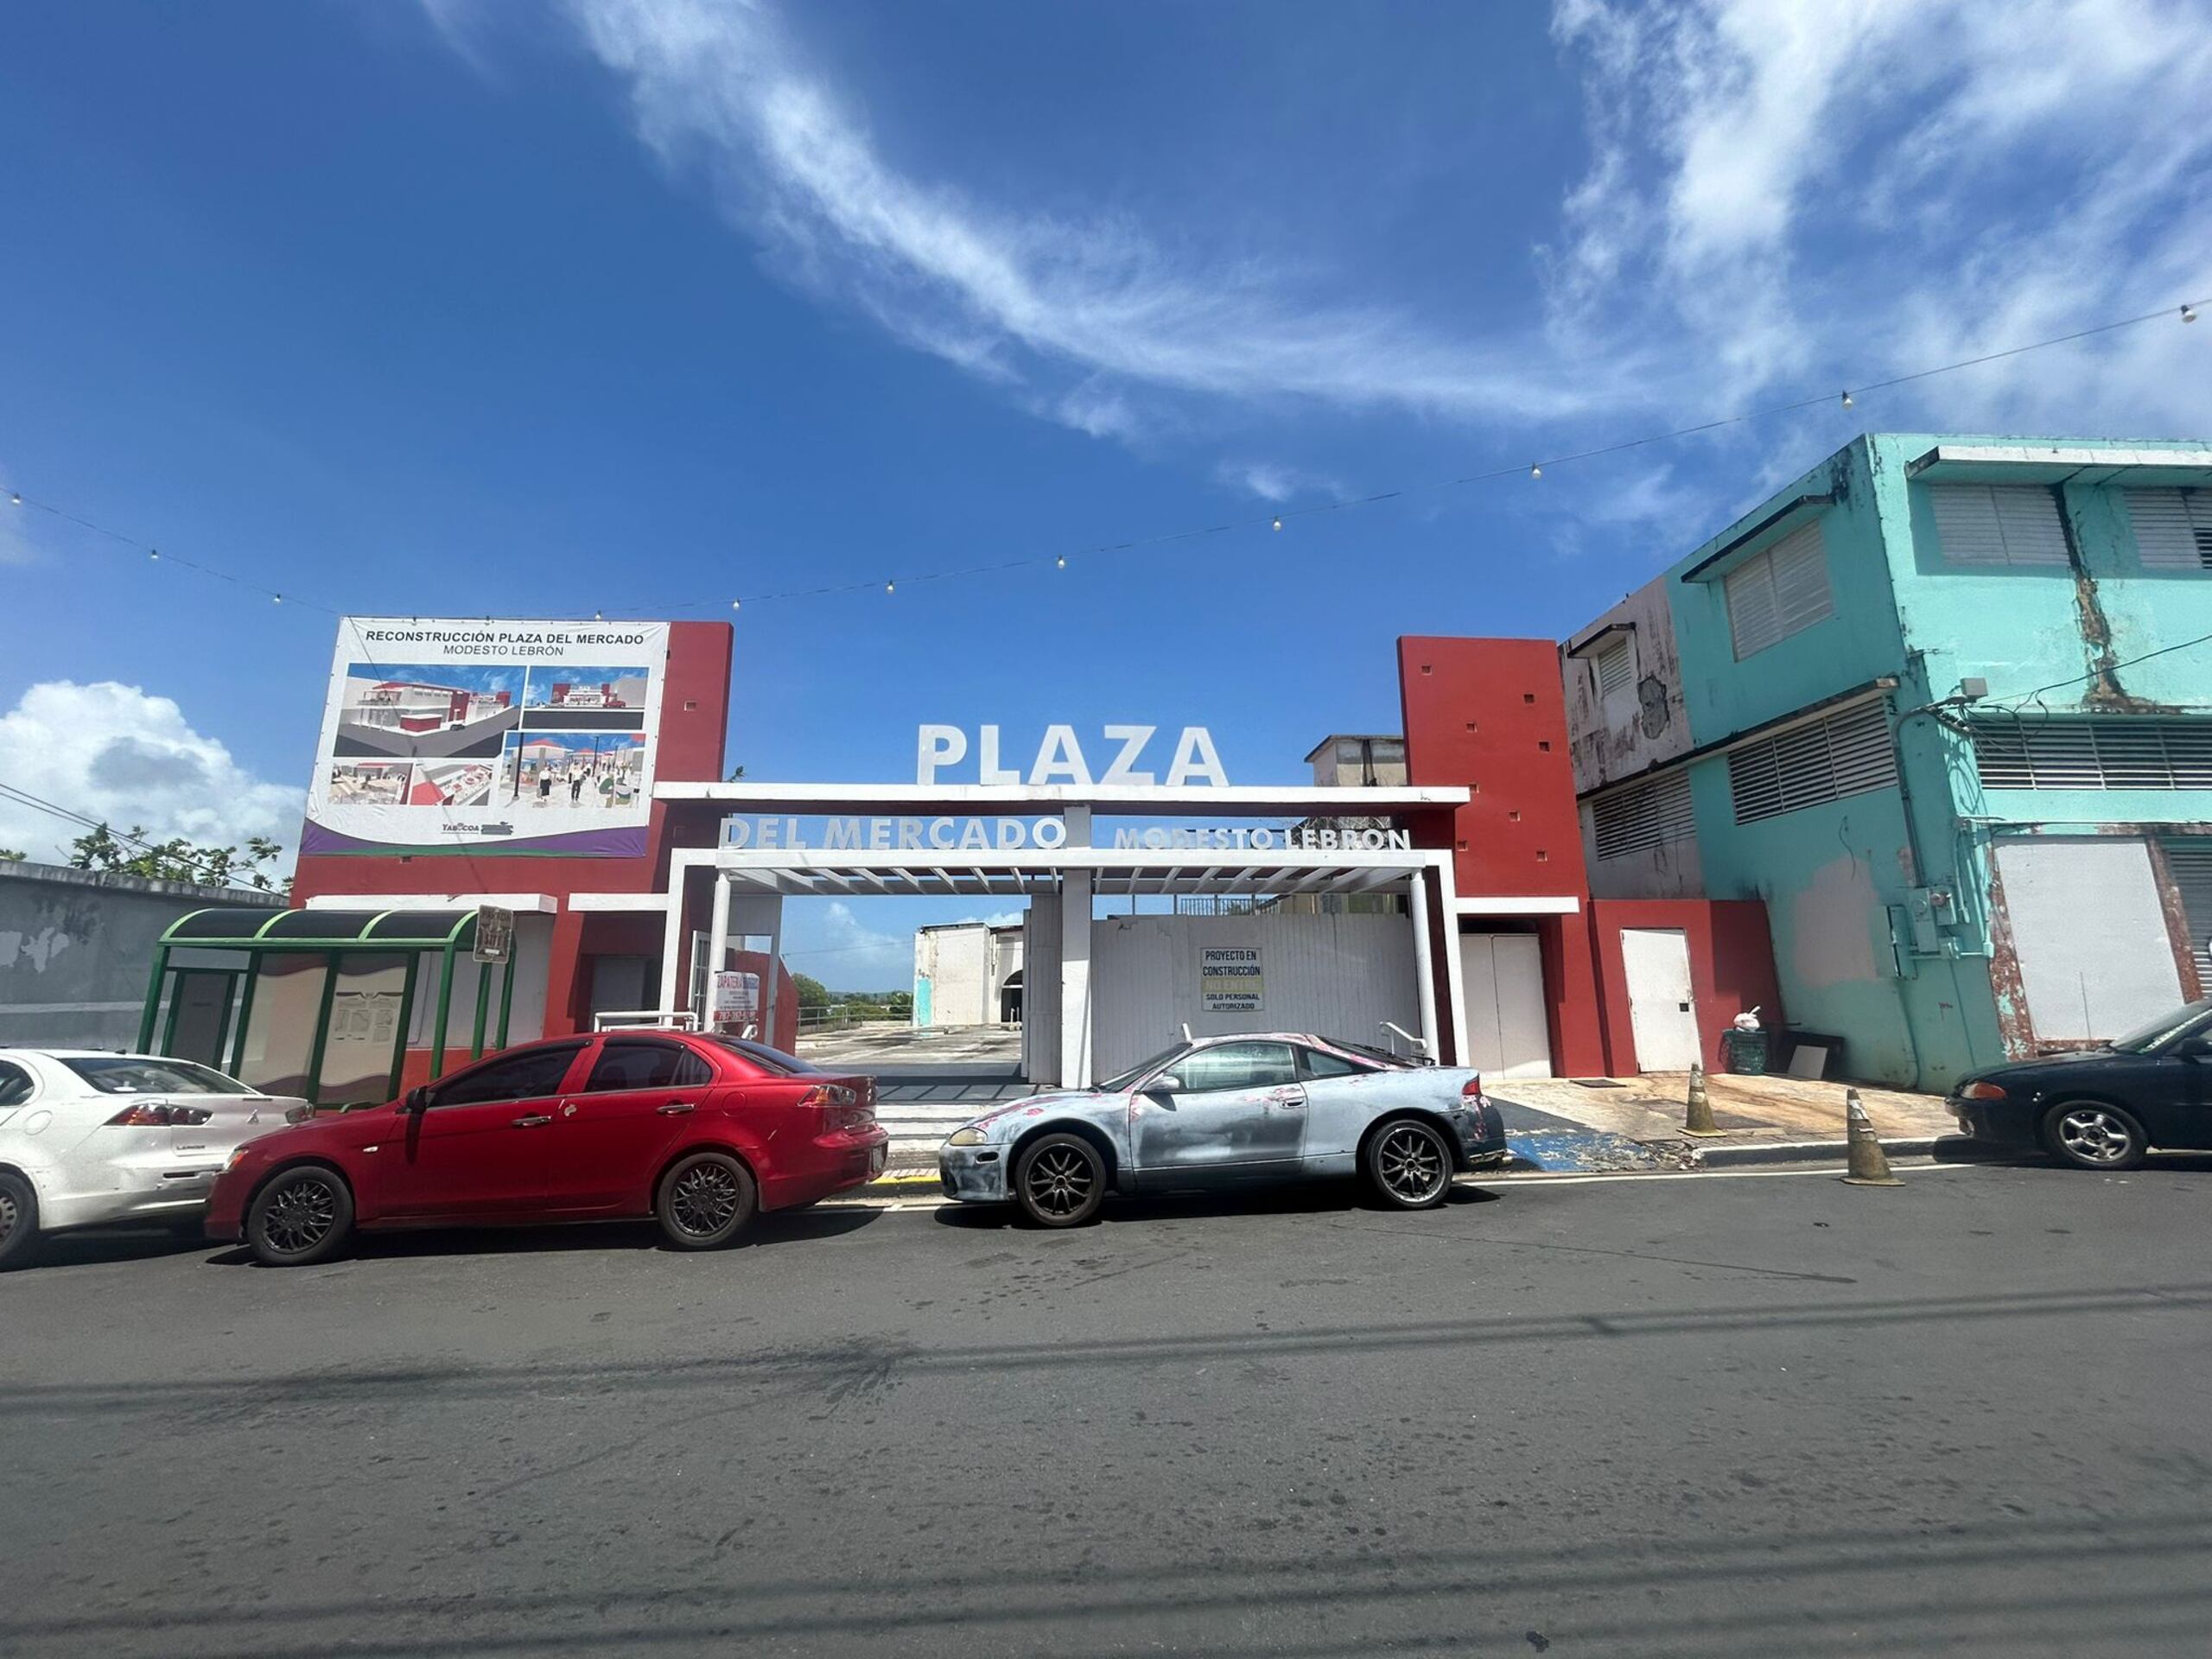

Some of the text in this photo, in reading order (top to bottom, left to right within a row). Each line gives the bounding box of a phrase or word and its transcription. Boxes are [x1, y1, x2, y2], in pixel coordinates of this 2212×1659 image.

[365, 631, 644, 645] RECONSTRUCCIÓN PLAZA DEL MERCADO
[443, 645, 563, 656] MODESTO LEBRÓN
[917, 724, 1230, 787] PLAZA
[718, 817, 1067, 850] DEL MERCADO
[1113, 827, 1411, 851] MODESTO LEBRON
[1205, 950, 1256, 961] PROYECTO EN
[1203, 963, 1260, 976] CONSTRUCCIÓN
